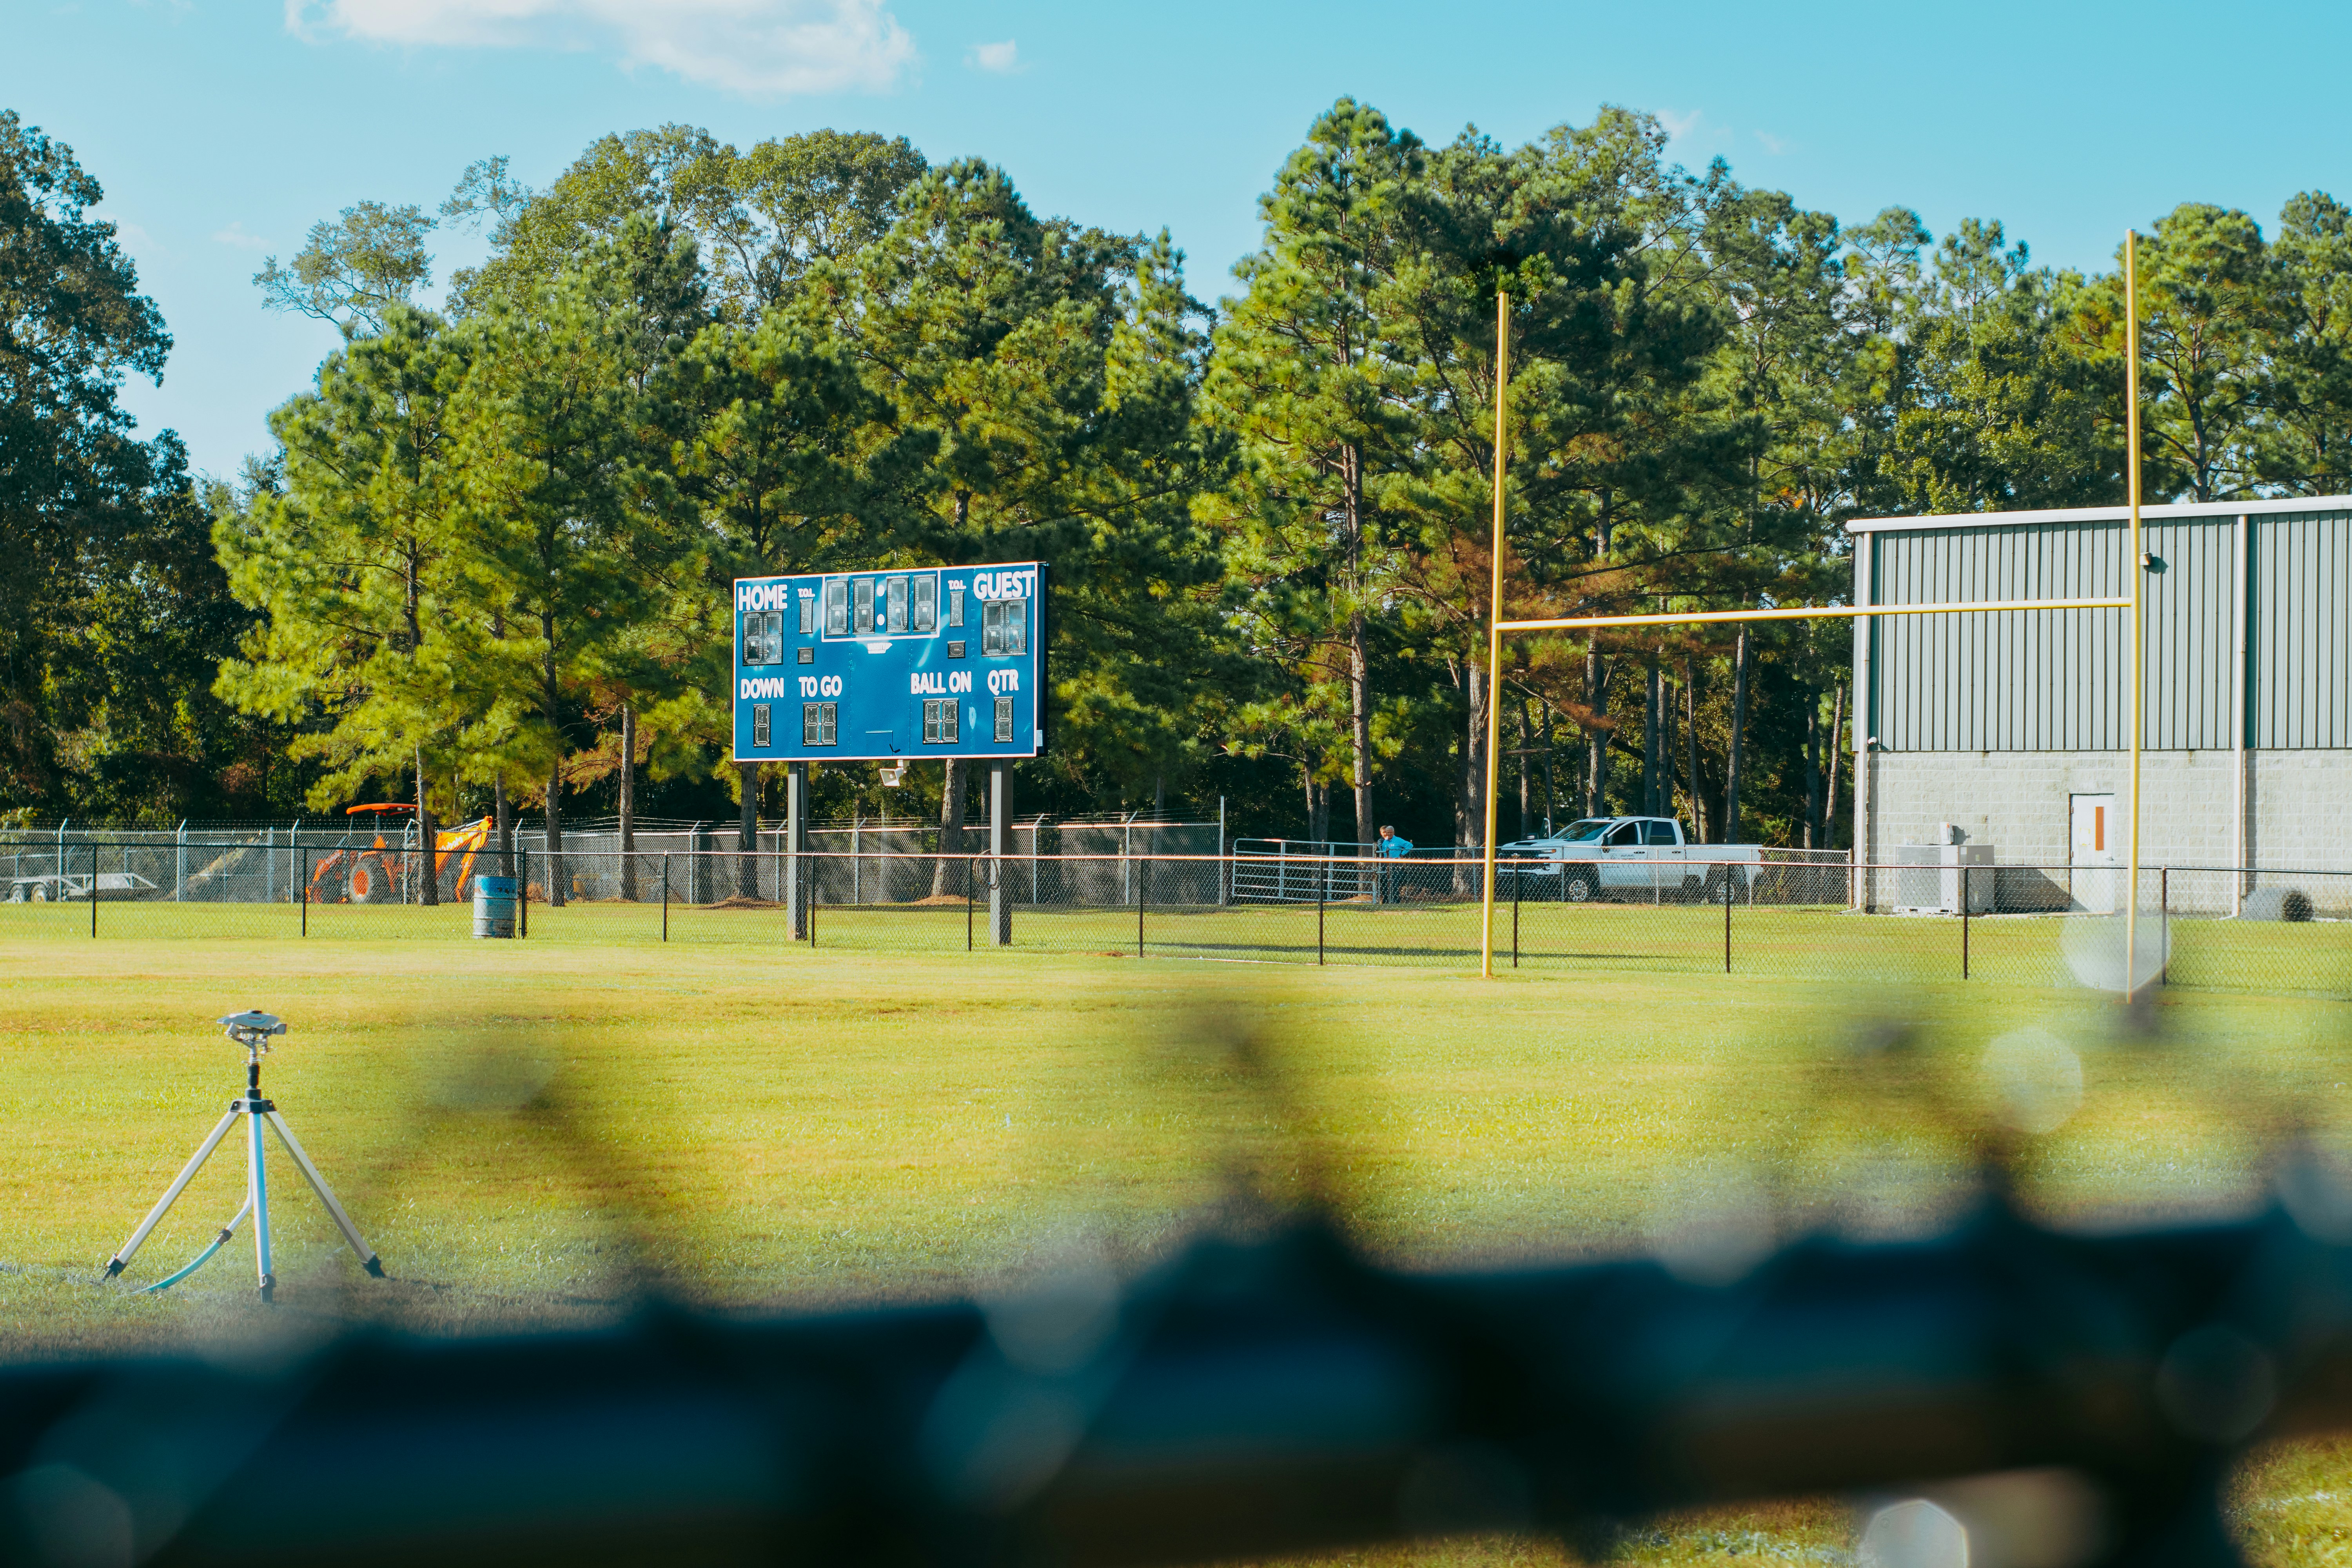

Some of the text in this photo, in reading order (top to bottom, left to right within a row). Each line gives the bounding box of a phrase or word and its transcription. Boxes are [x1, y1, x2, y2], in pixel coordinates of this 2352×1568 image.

[798, 588, 815, 597] T.O.L.
[948, 580, 966, 590] T.O.L.
[973, 570, 1035, 599] GUEST
[739, 584, 787, 611] HOME
[741, 678, 784, 699] DOWN
[799, 675, 842, 697] TO GO
[911, 671, 971, 694] BALL ON
[988, 669, 1018, 695] QTR
